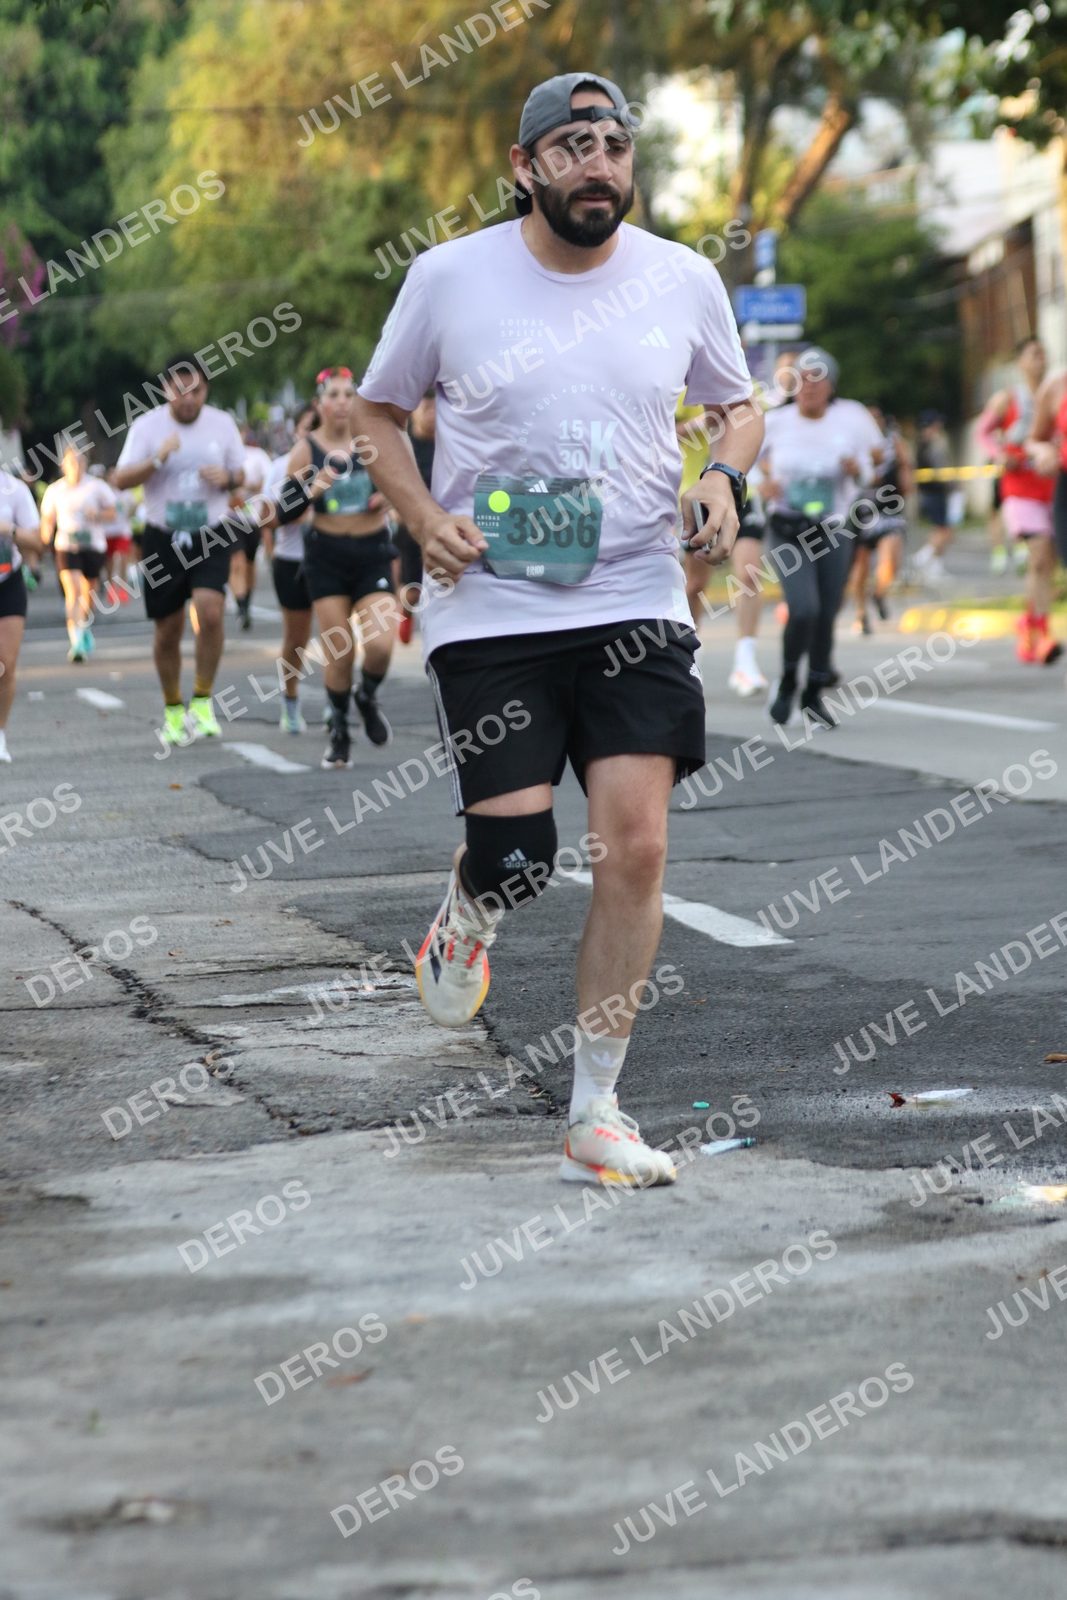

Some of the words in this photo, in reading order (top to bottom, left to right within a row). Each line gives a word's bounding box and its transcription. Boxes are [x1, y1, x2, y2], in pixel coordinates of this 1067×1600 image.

[559, 419, 584, 440] 15
[590, 421, 620, 471] K
[559, 450, 584, 471] 30
